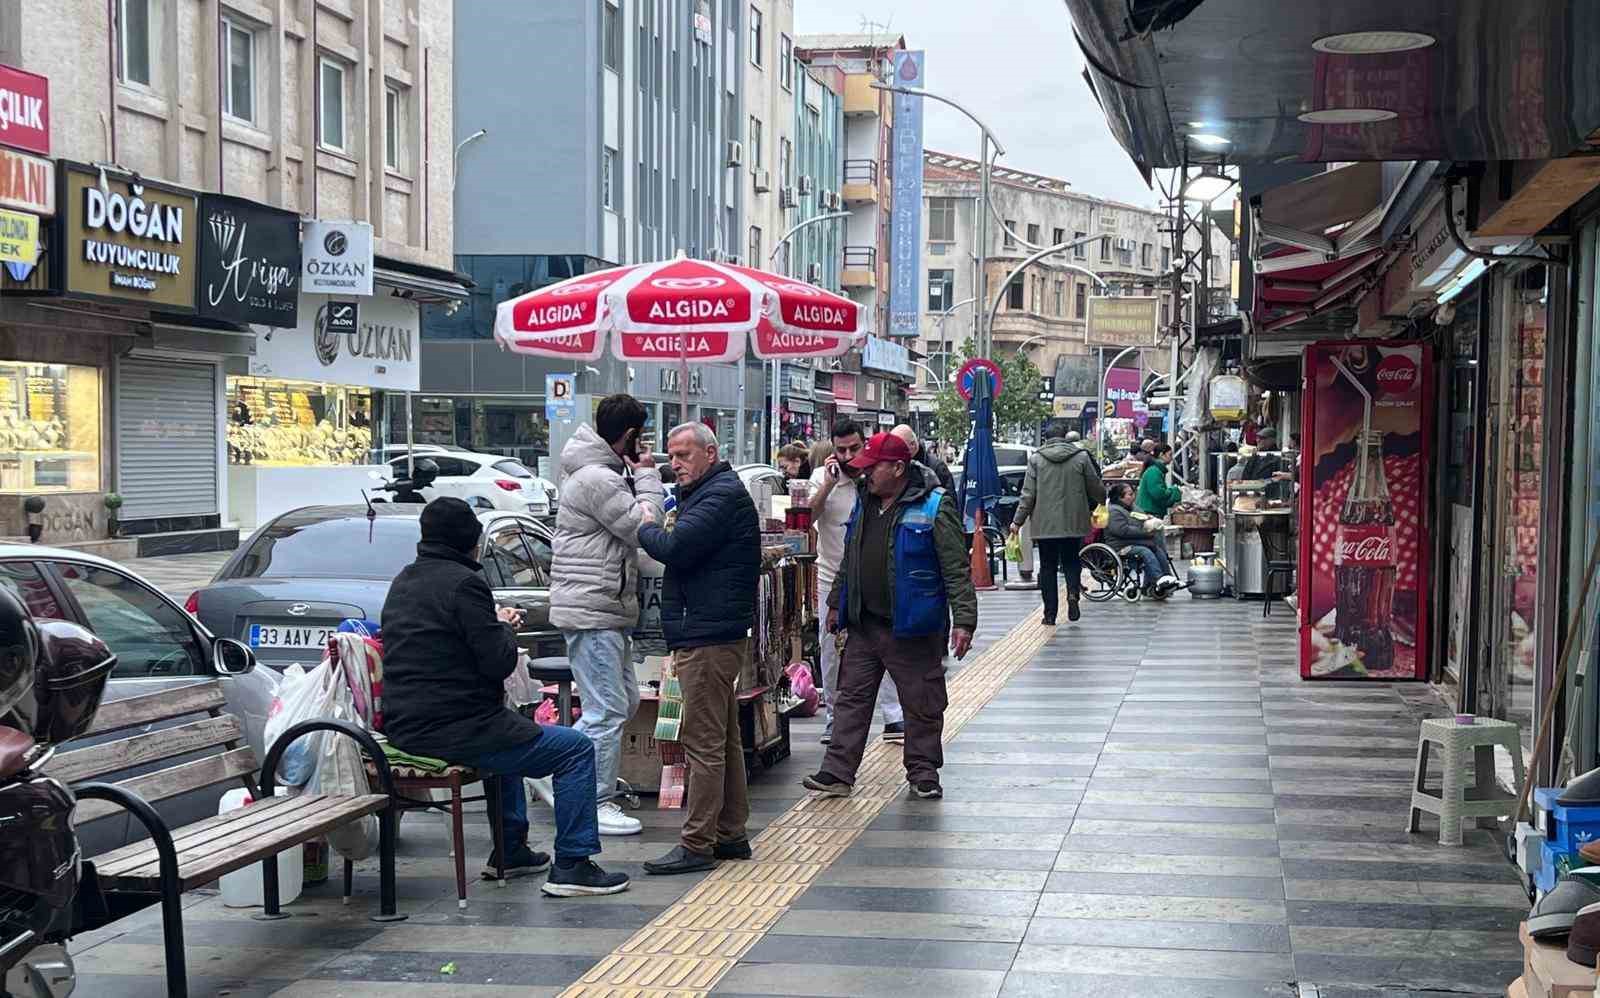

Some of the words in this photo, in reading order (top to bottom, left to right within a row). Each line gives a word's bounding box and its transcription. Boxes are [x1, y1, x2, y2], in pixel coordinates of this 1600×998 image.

[87, 185, 184, 244] DOĞAN
[86, 240, 181, 275] KUYUMCULUK
[306, 257, 366, 277] ÖZKAN
[648, 297, 729, 318] ALGiDA
[554, 381, 566, 398] D
[1336, 536, 1391, 561] ca-Cola
[261, 628, 278, 645] 33
[284, 628, 312, 646] AAV
